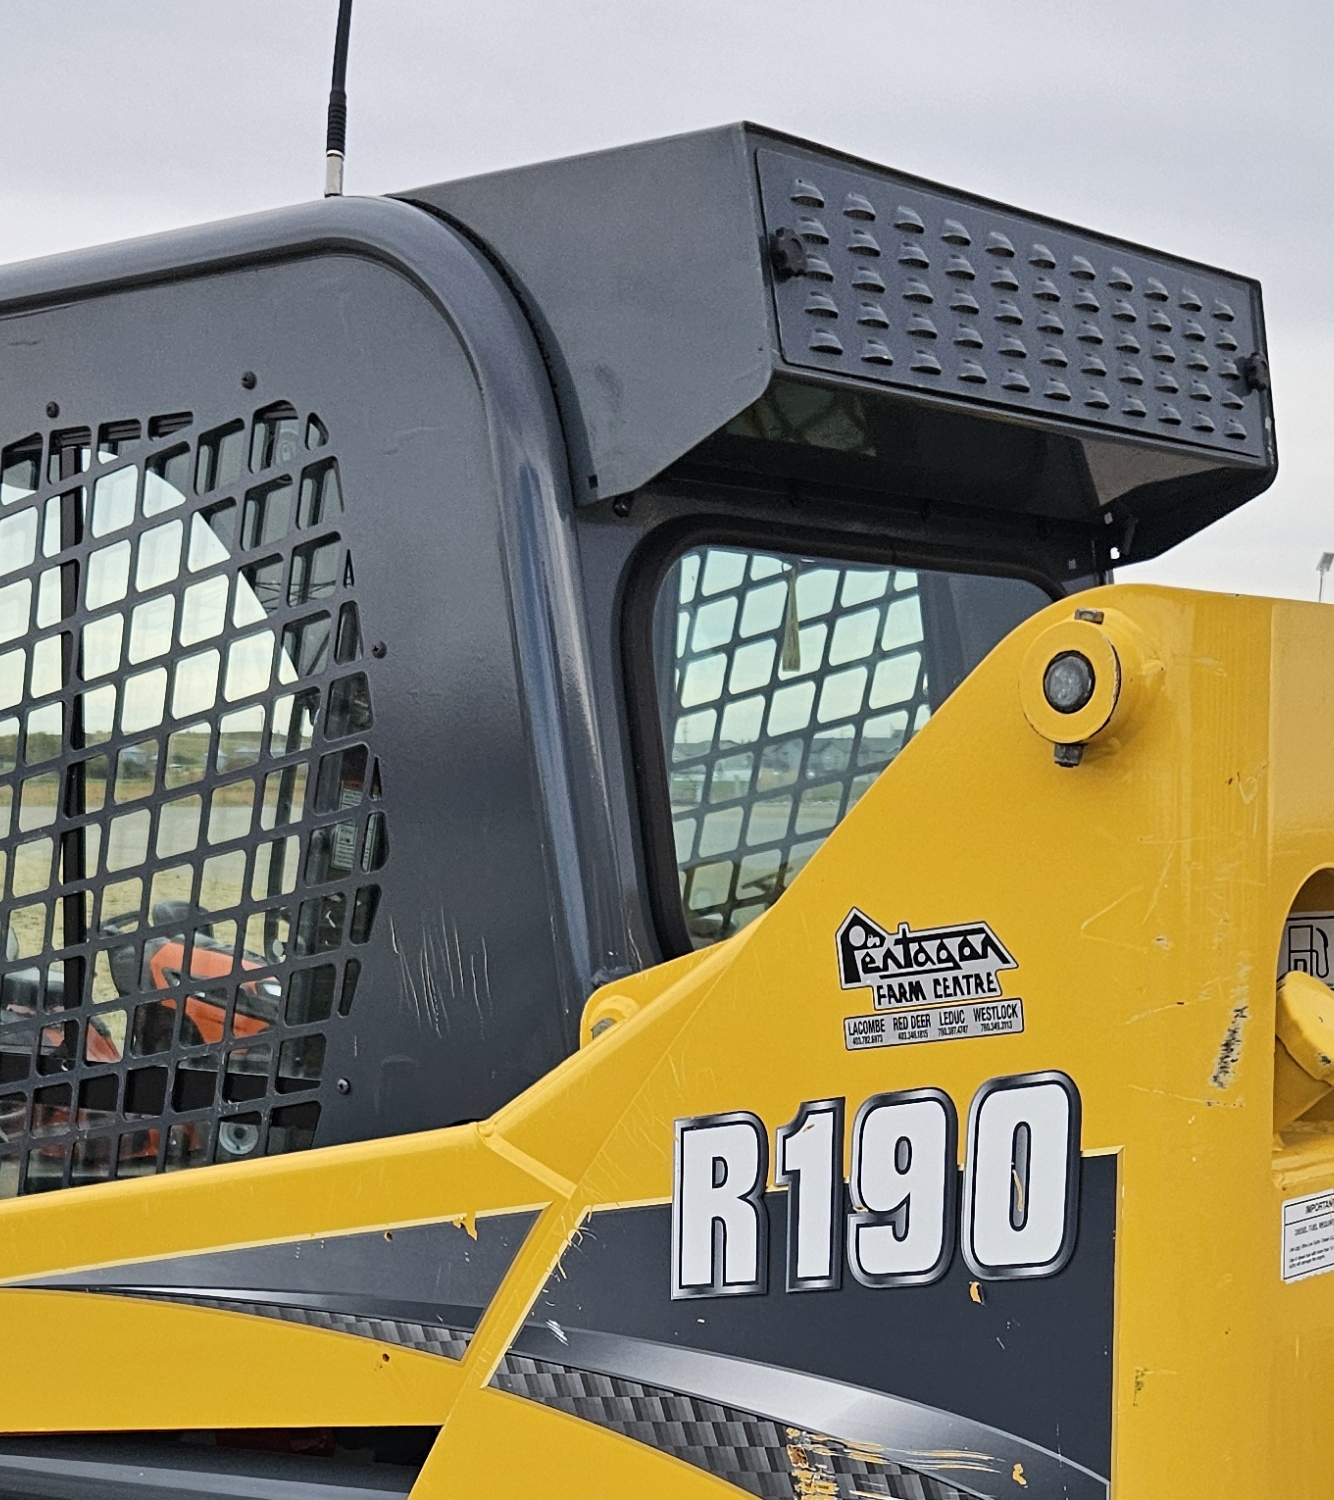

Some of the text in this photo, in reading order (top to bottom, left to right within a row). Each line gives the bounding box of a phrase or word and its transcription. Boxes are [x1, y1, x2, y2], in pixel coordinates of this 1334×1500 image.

[877, 972, 997, 1006] FARM CENTRE
[848, 1003, 1019, 1036] LACOMBE RED DEER LEDUC WESTLOCK
[670, 1070, 1083, 1301] R190
